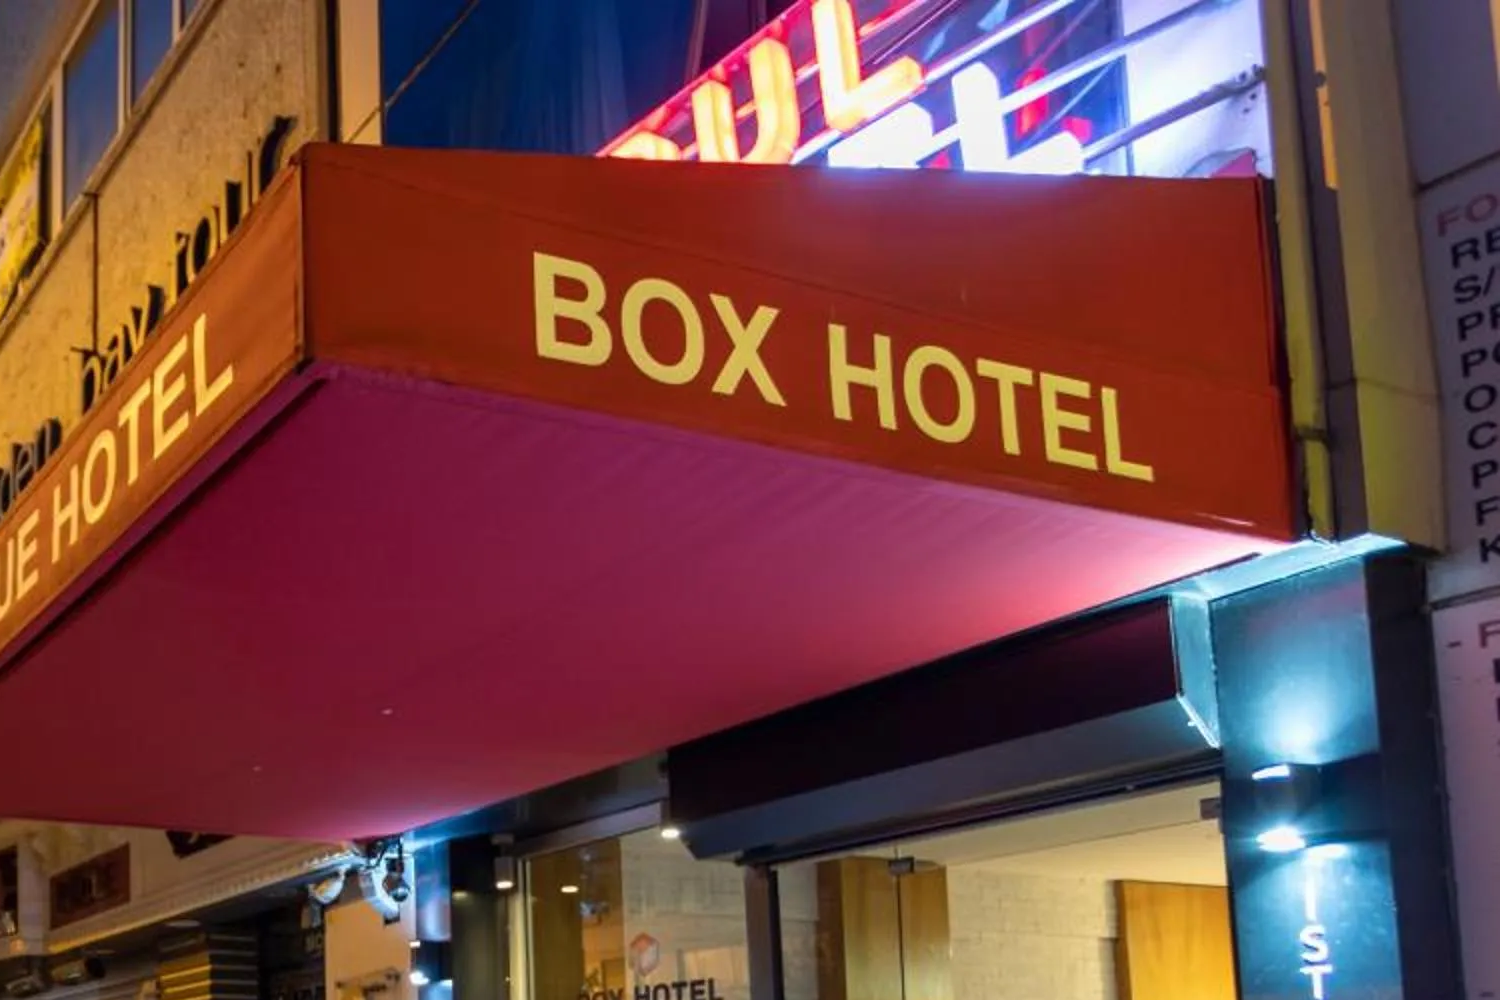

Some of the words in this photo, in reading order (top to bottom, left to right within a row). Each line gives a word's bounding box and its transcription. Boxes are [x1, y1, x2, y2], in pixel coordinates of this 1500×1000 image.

[52, 313, 233, 564] HOTEL
[533, 252, 787, 407] BOX
[828, 323, 1154, 482] HOTEL
